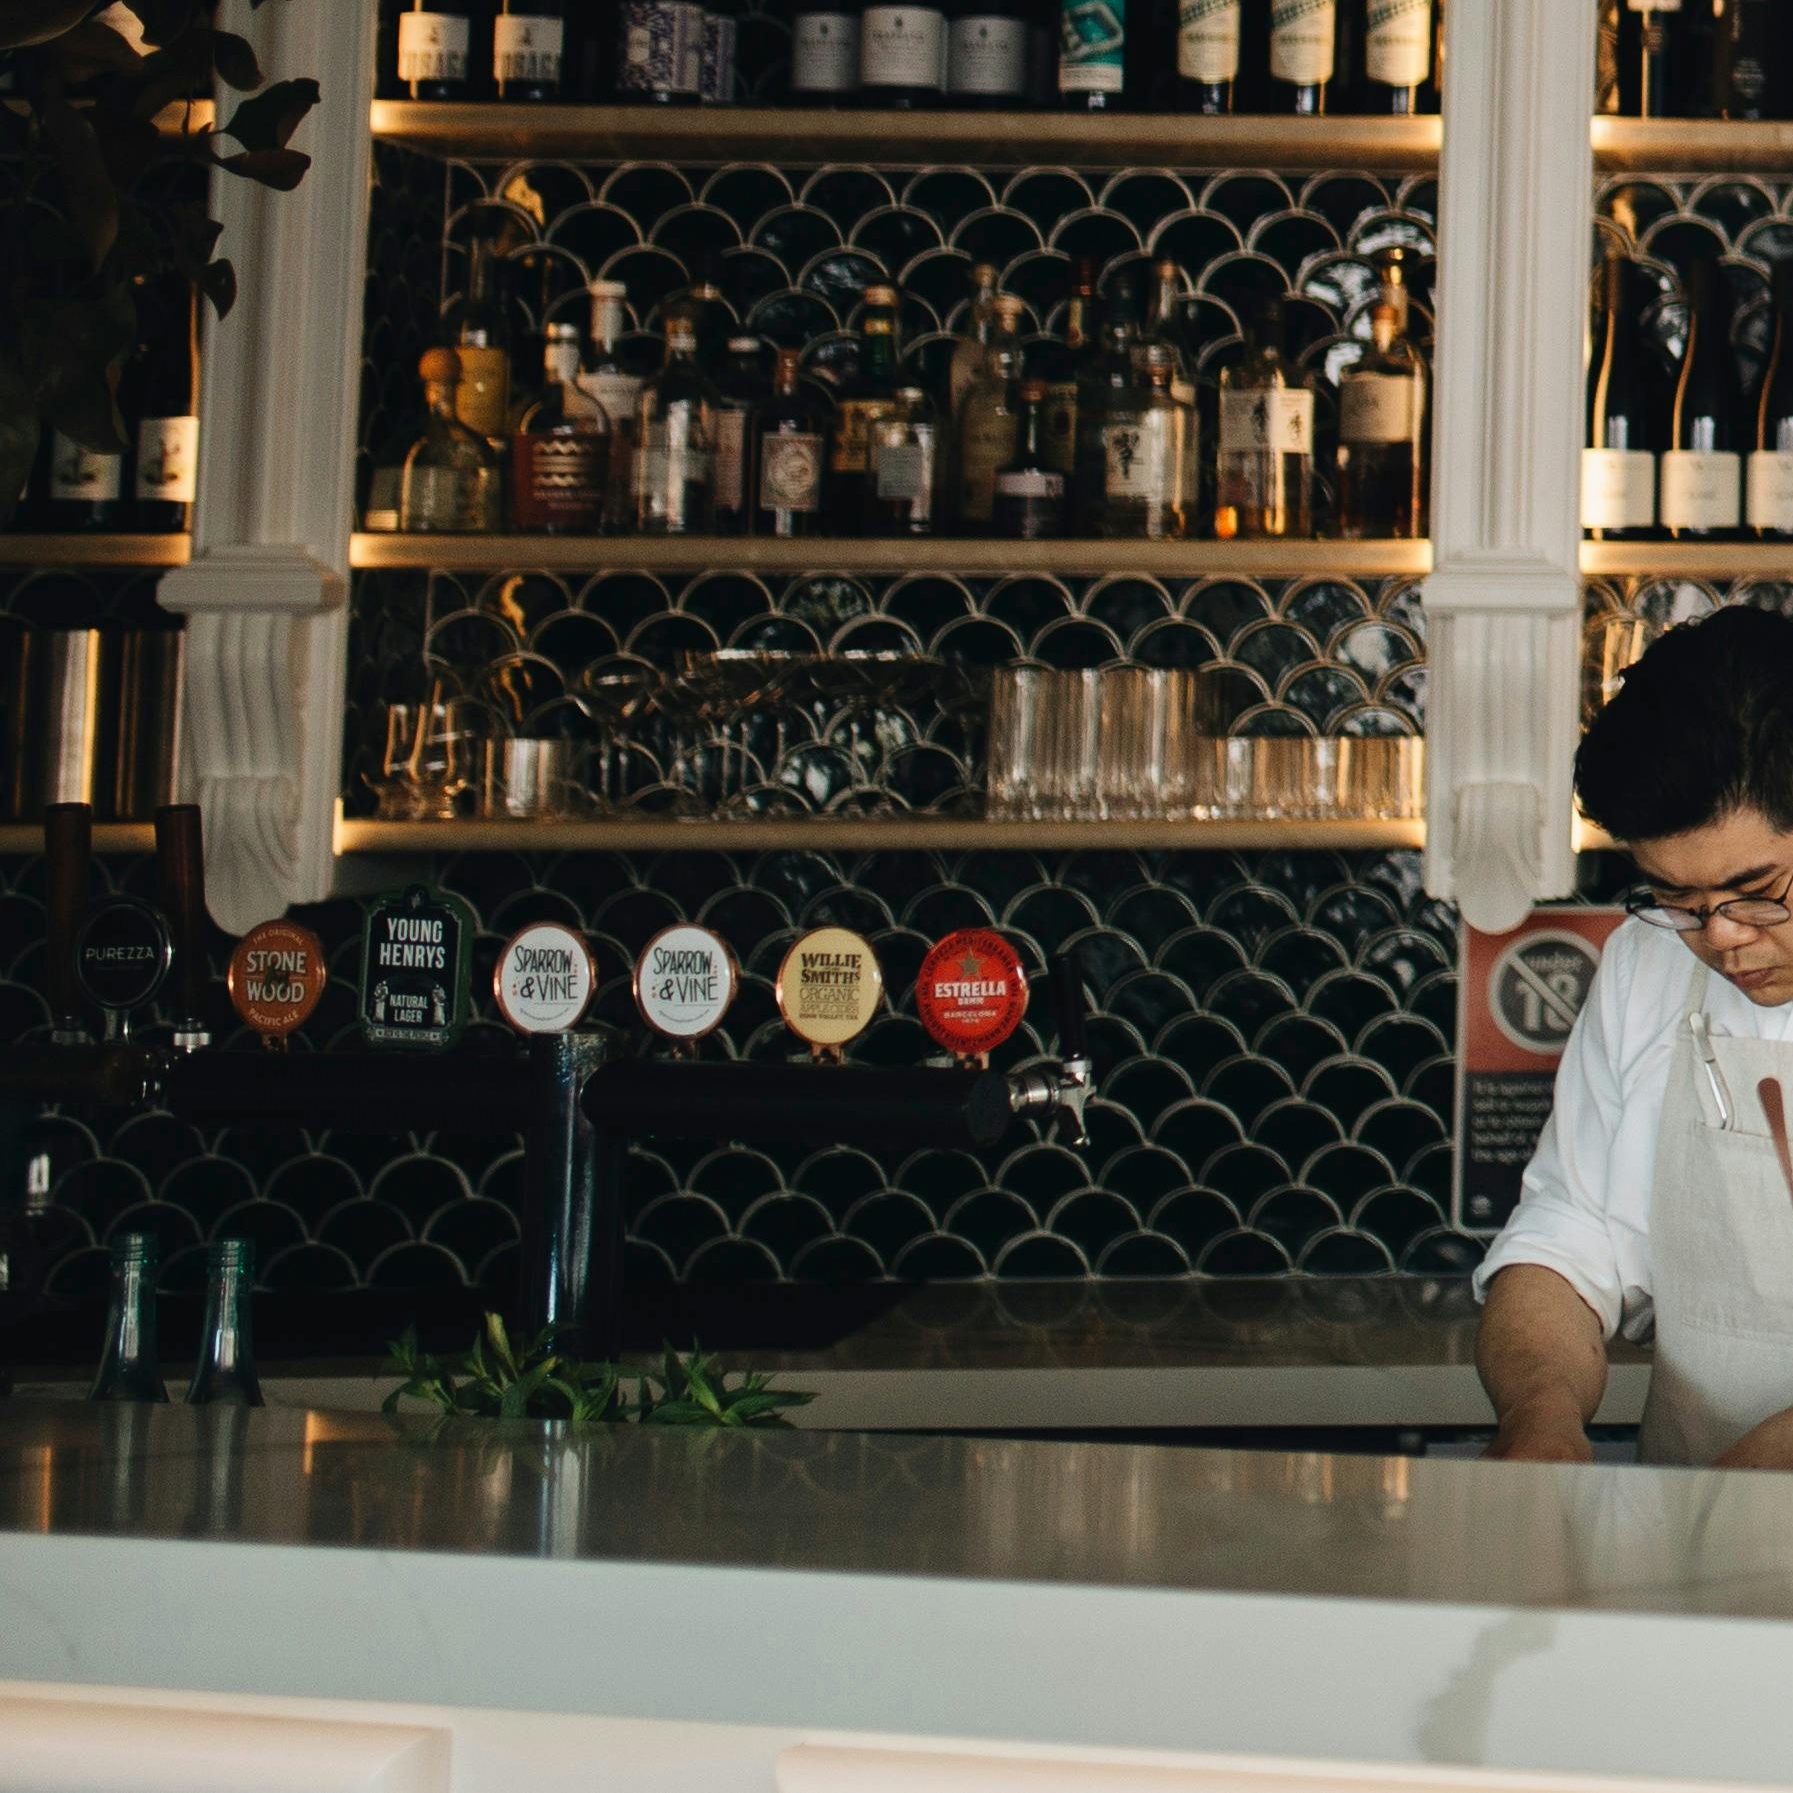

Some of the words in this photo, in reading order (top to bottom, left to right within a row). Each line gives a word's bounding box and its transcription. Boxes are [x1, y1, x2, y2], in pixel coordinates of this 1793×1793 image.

[387, 917, 443, 944] YOUNG
[86, 946, 155, 961] PUREZZA
[246, 950, 307, 974] STONE
[379, 942, 446, 969] HENRYS
[514, 945, 573, 974] SPARROW
[653, 947, 713, 976] SPARROW
[801, 952, 862, 968] WILLIE
[246, 979, 305, 1004] WOOD
[799, 987, 860, 1001] ORGANIC
[934, 980, 1006, 998] ESTRELLA
[389, 994, 429, 1009] NATURAL
[1513, 971, 1581, 1032] 18
[250, 1007, 282, 1028] PACIFIC
[282, 1009, 299, 1025] ALE
[394, 1009, 423, 1024] LAGER
